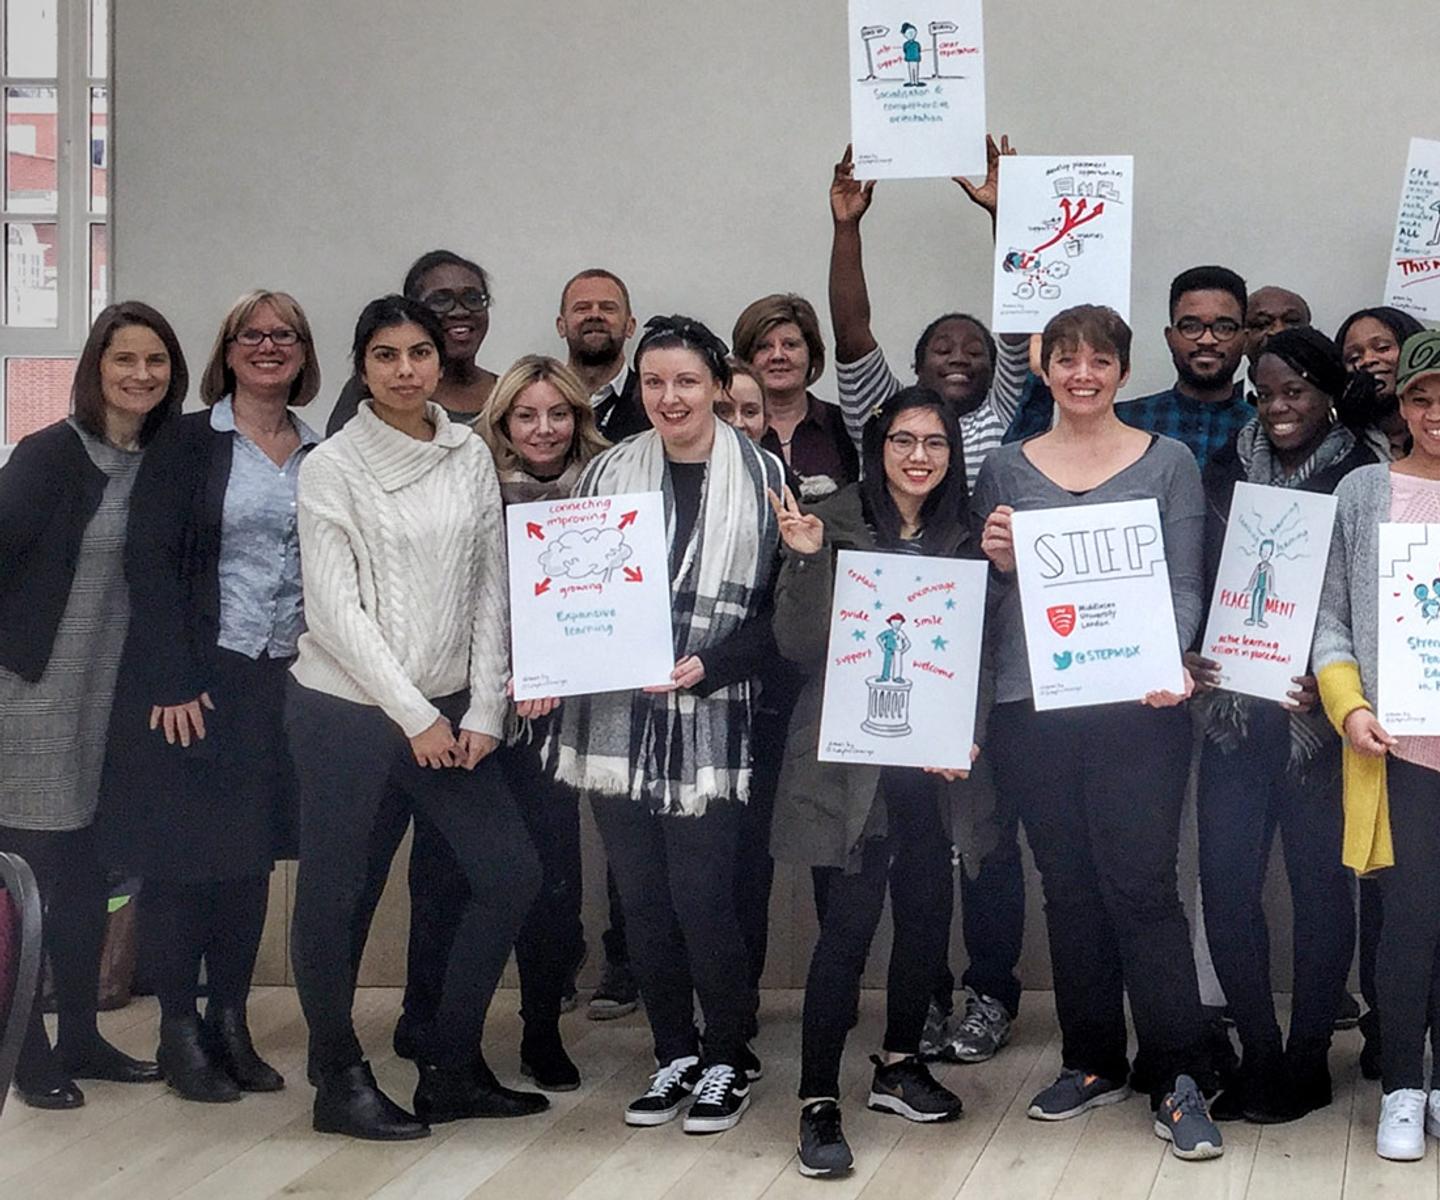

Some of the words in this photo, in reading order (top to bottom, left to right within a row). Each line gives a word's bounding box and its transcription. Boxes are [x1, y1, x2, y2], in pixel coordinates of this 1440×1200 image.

[1400, 228, 1420, 238] ALL
[1397, 260, 1430, 276] THIS
[549, 499, 612, 513] connecting
[547, 512, 607, 526] improving
[1034, 525, 1158, 579] STEP
[559, 583, 603, 597] growing
[907, 581, 956, 602] encourage
[556, 609, 616, 622] Expansive
[840, 609, 870, 622] guide
[1081, 611, 1116, 620] University
[564, 625, 613, 636] learning
[1081, 620, 1110, 629] London
[1243, 635, 1279, 652] learning
[836, 649, 872, 666] support
[1250, 651, 1291, 664] placement
[913, 659, 955, 680] welcome
